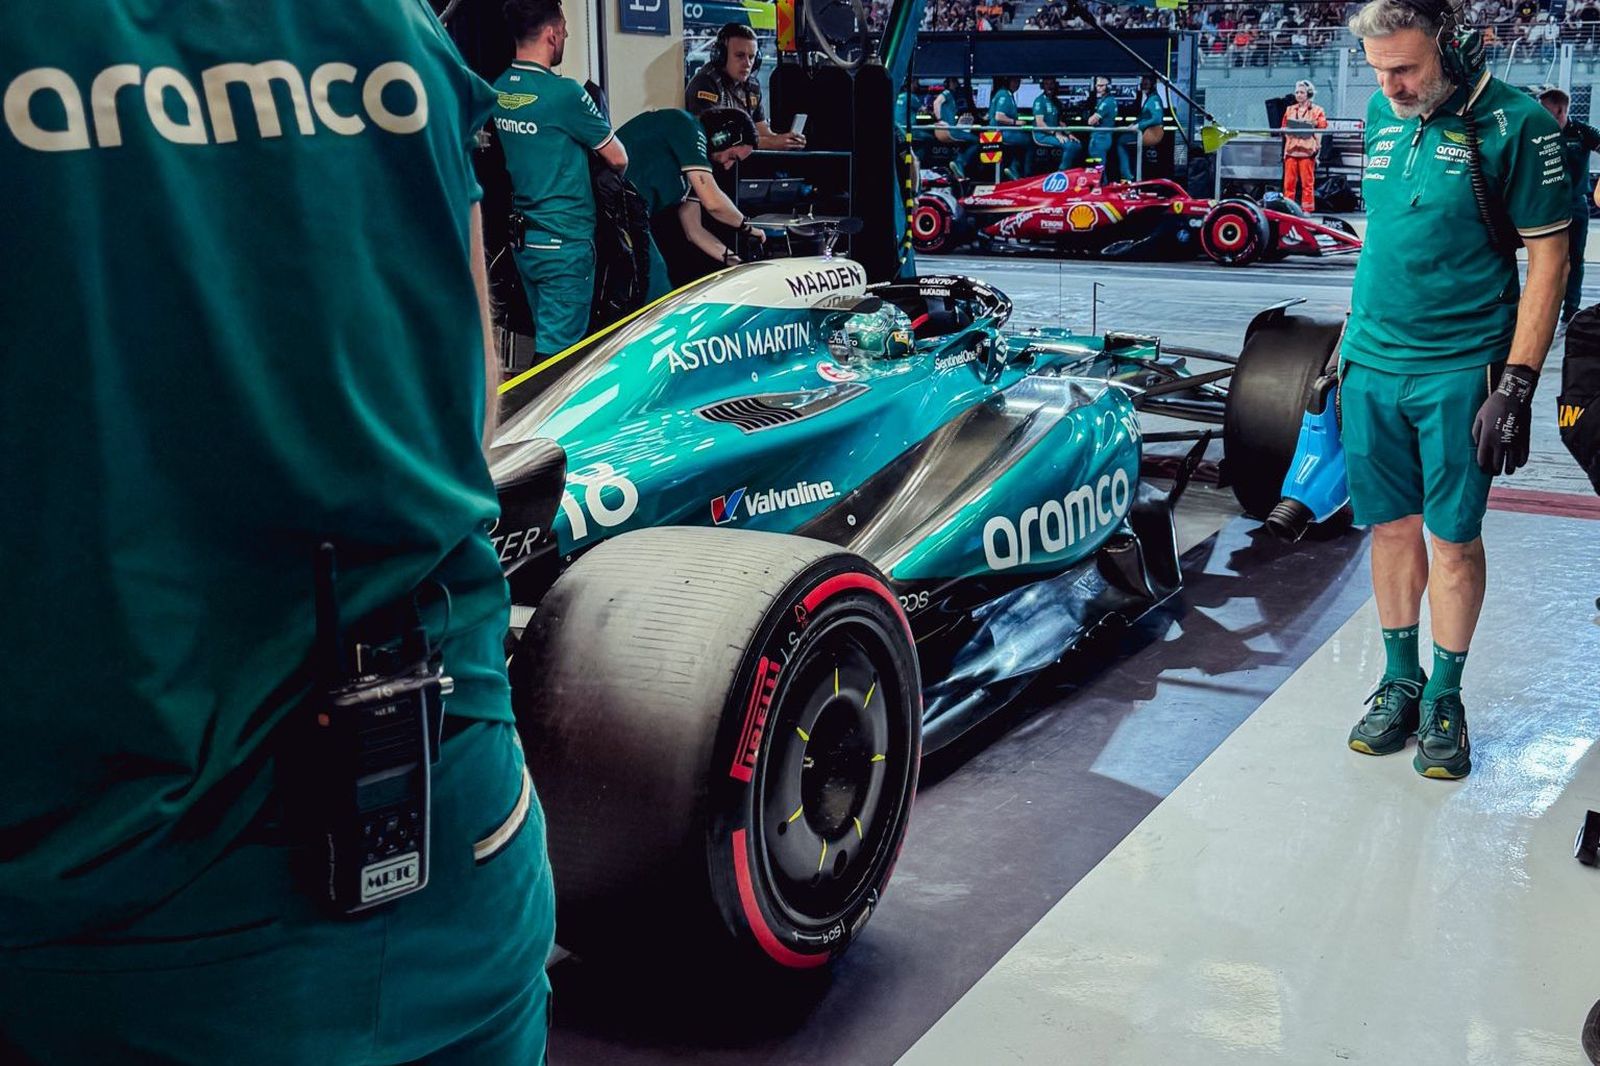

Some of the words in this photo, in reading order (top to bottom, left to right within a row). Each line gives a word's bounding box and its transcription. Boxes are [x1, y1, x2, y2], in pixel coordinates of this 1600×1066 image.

[3, 59, 429, 152] aramco
[1046, 172, 1066, 192] hp
[667, 332, 742, 374] ASTON
[745, 321, 811, 358] MARTIN
[560, 462, 639, 541] 18
[983, 467, 1130, 571] aramco
